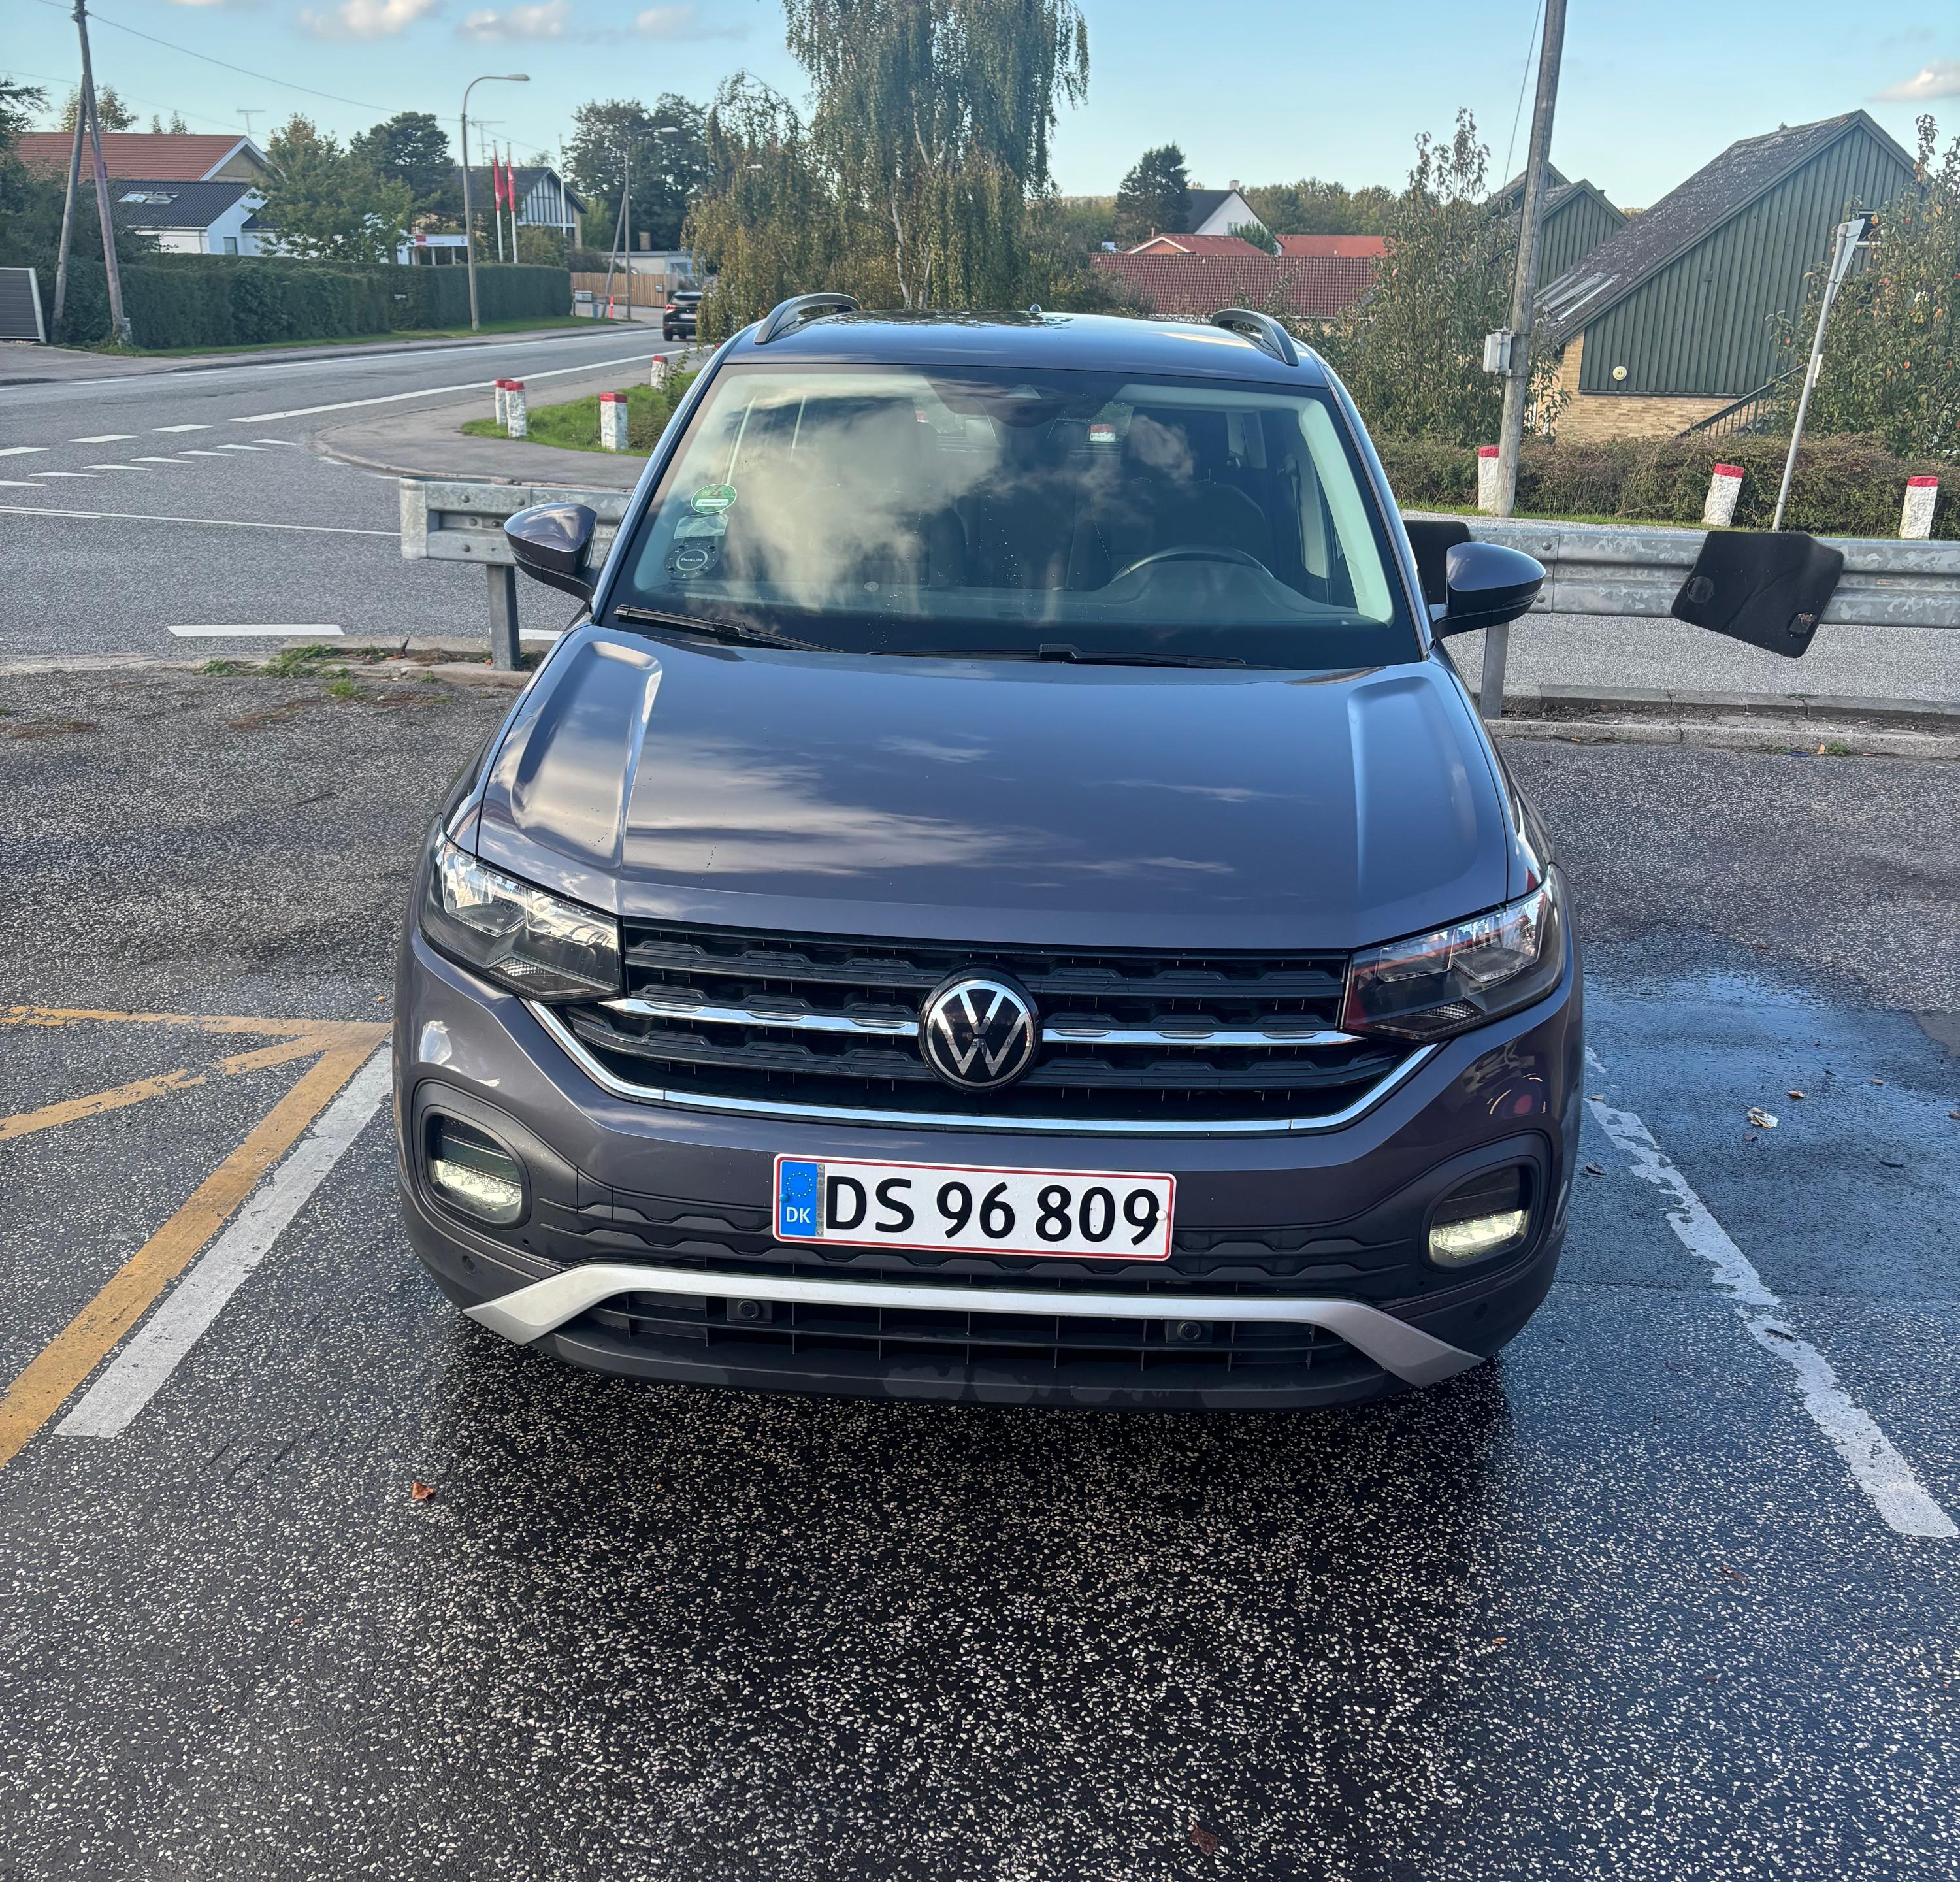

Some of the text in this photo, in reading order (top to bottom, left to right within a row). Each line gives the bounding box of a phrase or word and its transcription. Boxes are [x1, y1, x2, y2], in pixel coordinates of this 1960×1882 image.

[928, 980, 1034, 1087] VW
[786, 1206, 811, 1224] DK
[826, 1175, 1160, 1246] DS 96 809
